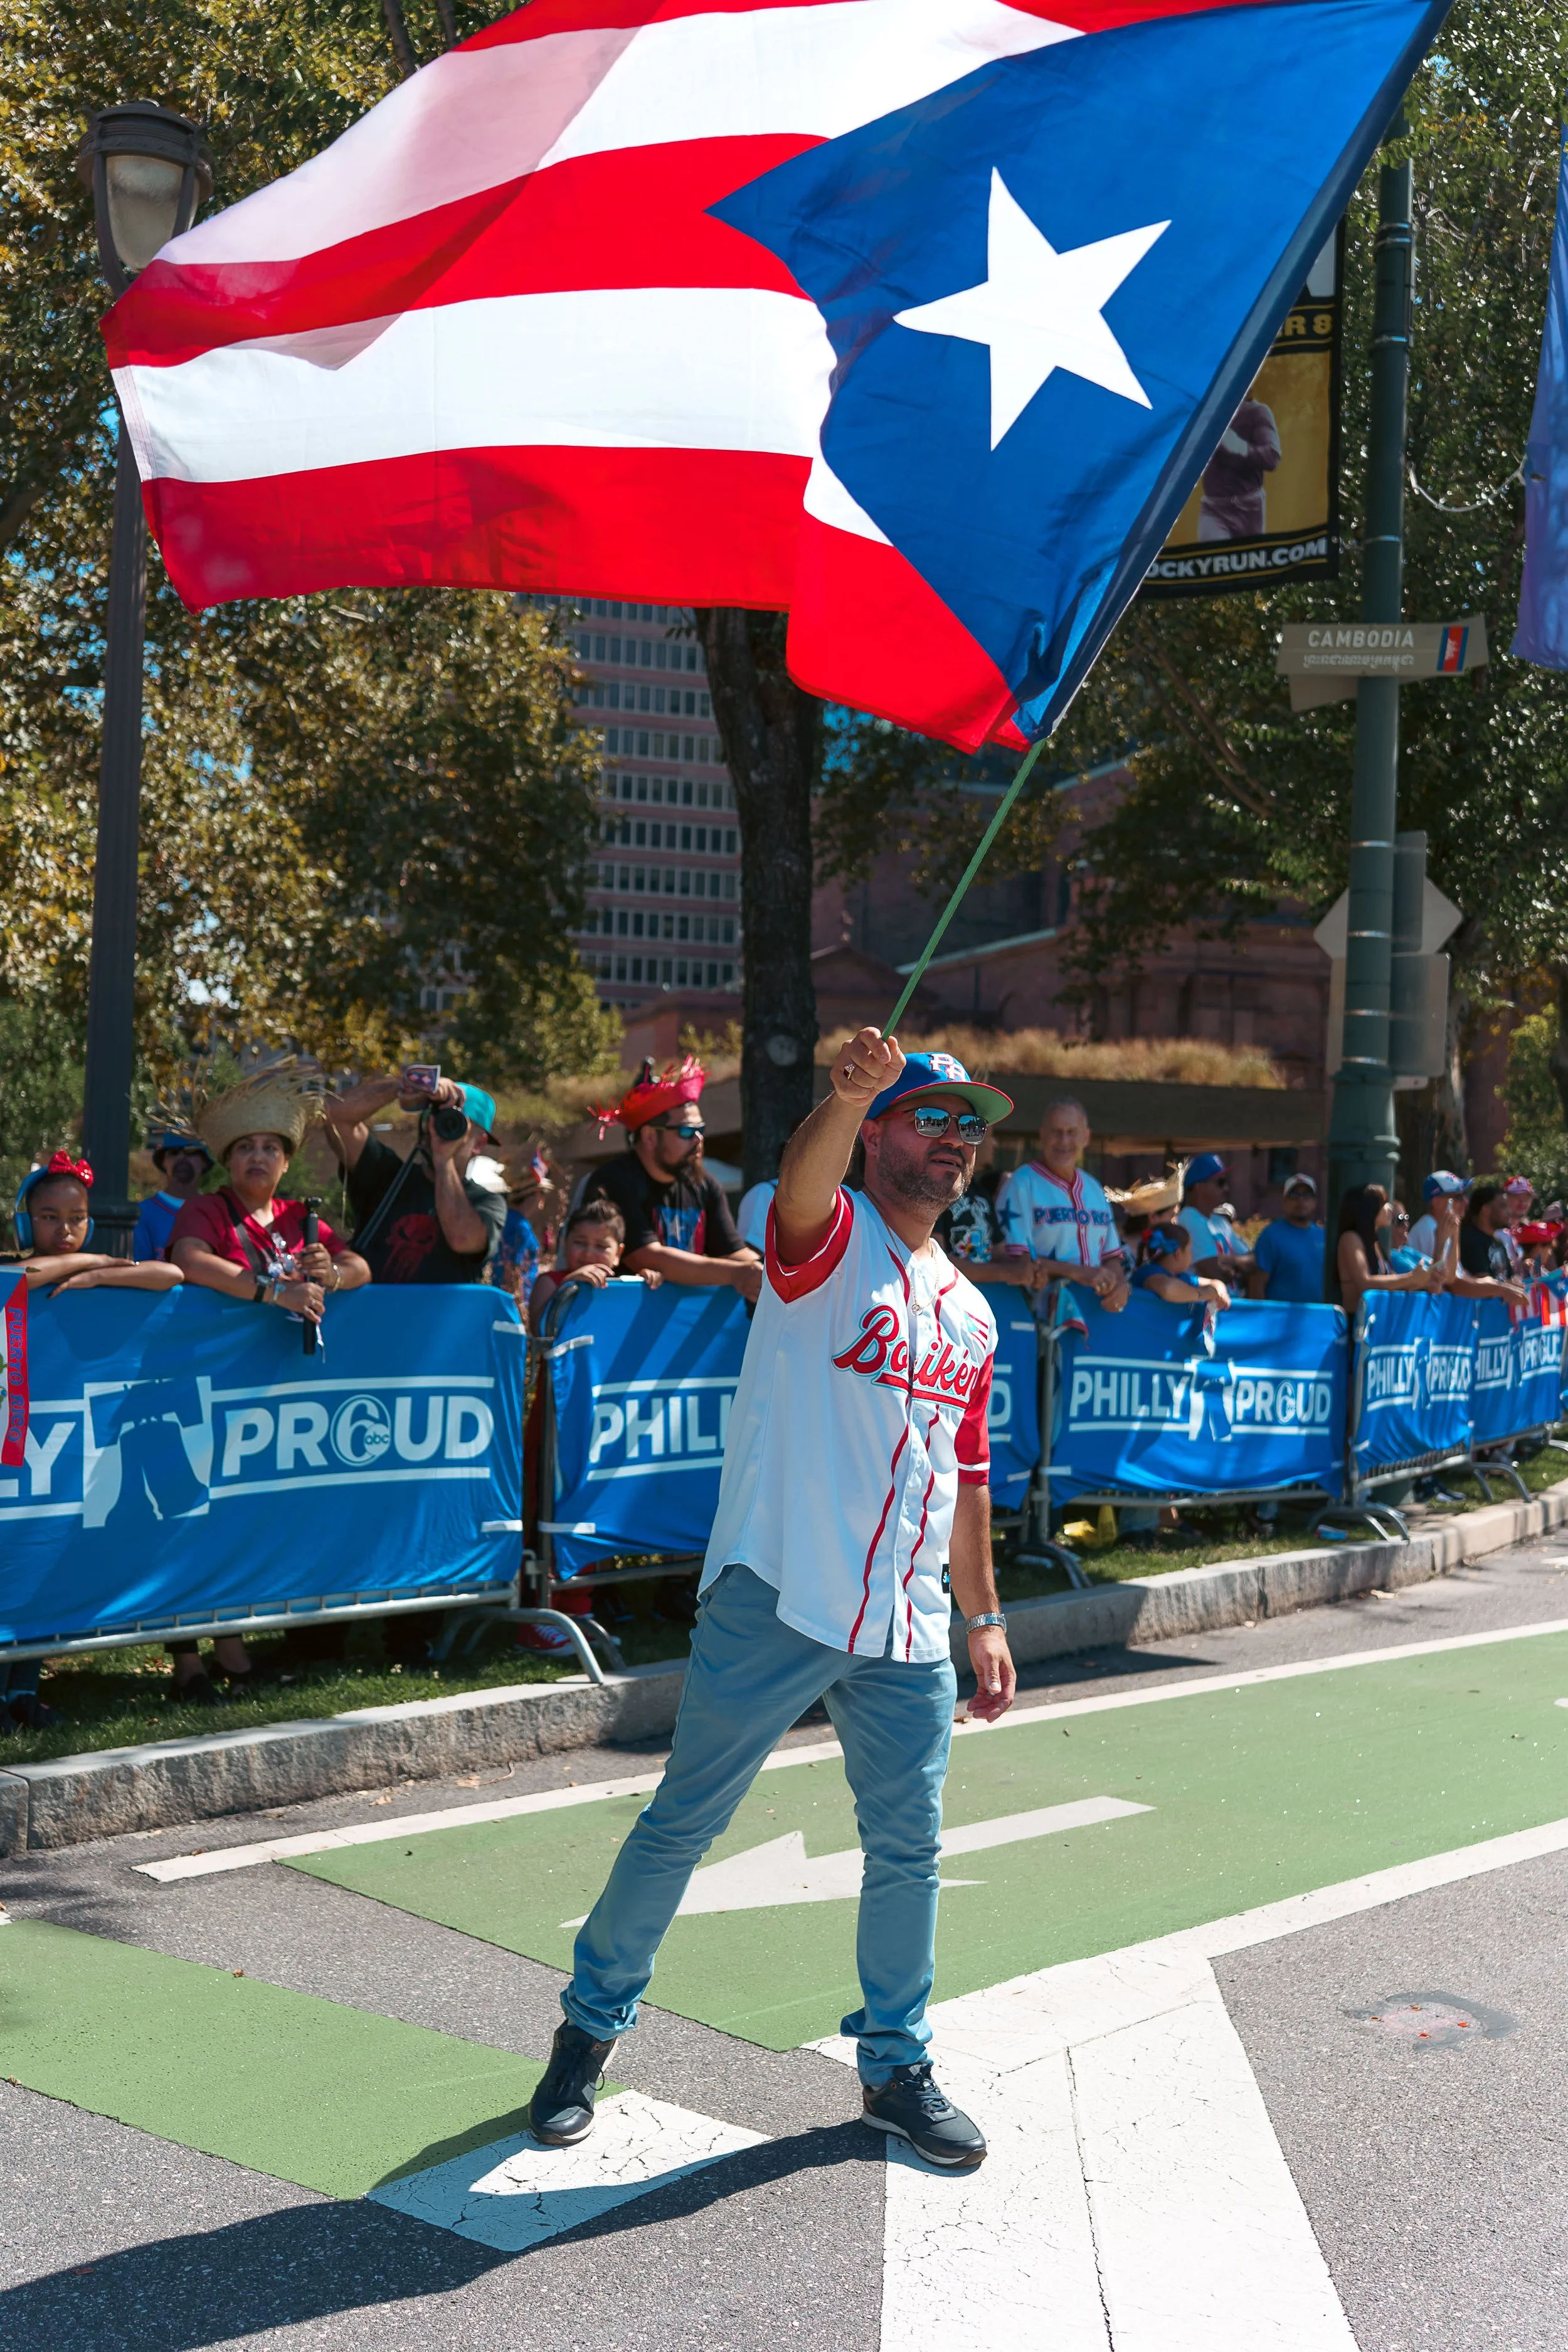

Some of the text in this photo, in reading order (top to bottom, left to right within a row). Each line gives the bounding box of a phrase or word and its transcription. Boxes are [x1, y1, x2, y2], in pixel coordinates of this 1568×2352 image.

[1277, 314, 1332, 336] R 8
[1308, 629, 1414, 649] CAMBODIA
[1032, 1205, 1089, 1227] PUERTO
[831, 1302, 978, 1399] Boikén
[8, 1306, 24, 1443] PUERTO RICO
[1069, 1370, 1190, 1419] PHILLY
[1367, 1355, 1414, 1400] PHILLY
